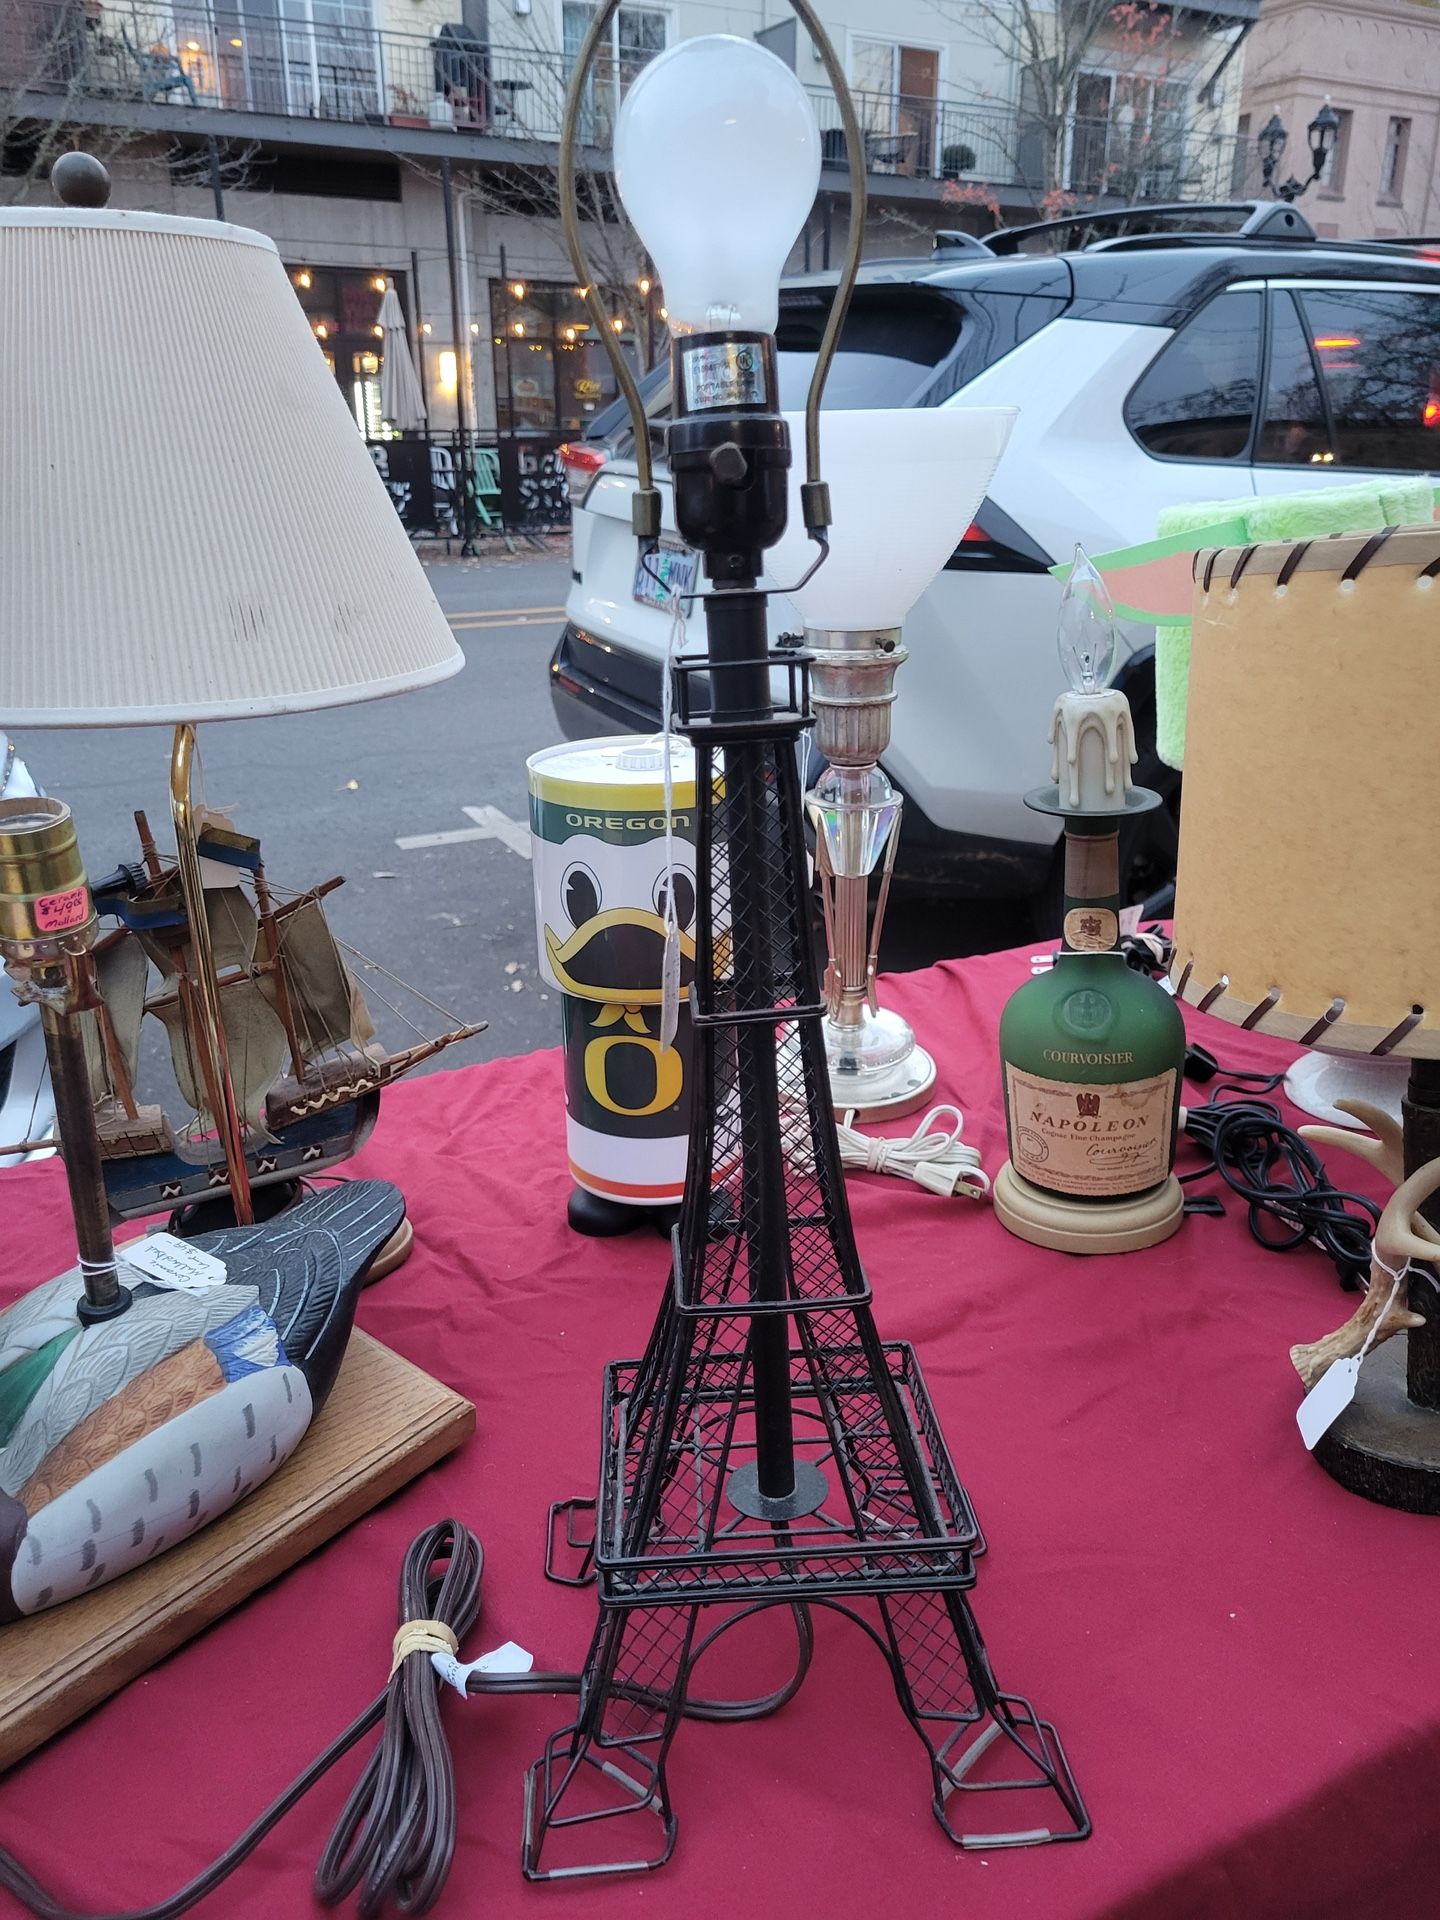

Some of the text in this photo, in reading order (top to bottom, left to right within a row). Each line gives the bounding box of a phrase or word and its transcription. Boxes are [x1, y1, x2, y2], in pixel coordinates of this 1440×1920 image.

[565, 813, 690, 830] OREGON
[1043, 1049, 1134, 1065] COURVOISIER
[584, 1035, 684, 1117] O
[1030, 1111, 1150, 1133] NAPOLEON
[1041, 1128, 1137, 1143] Cognac Fine Champagne
